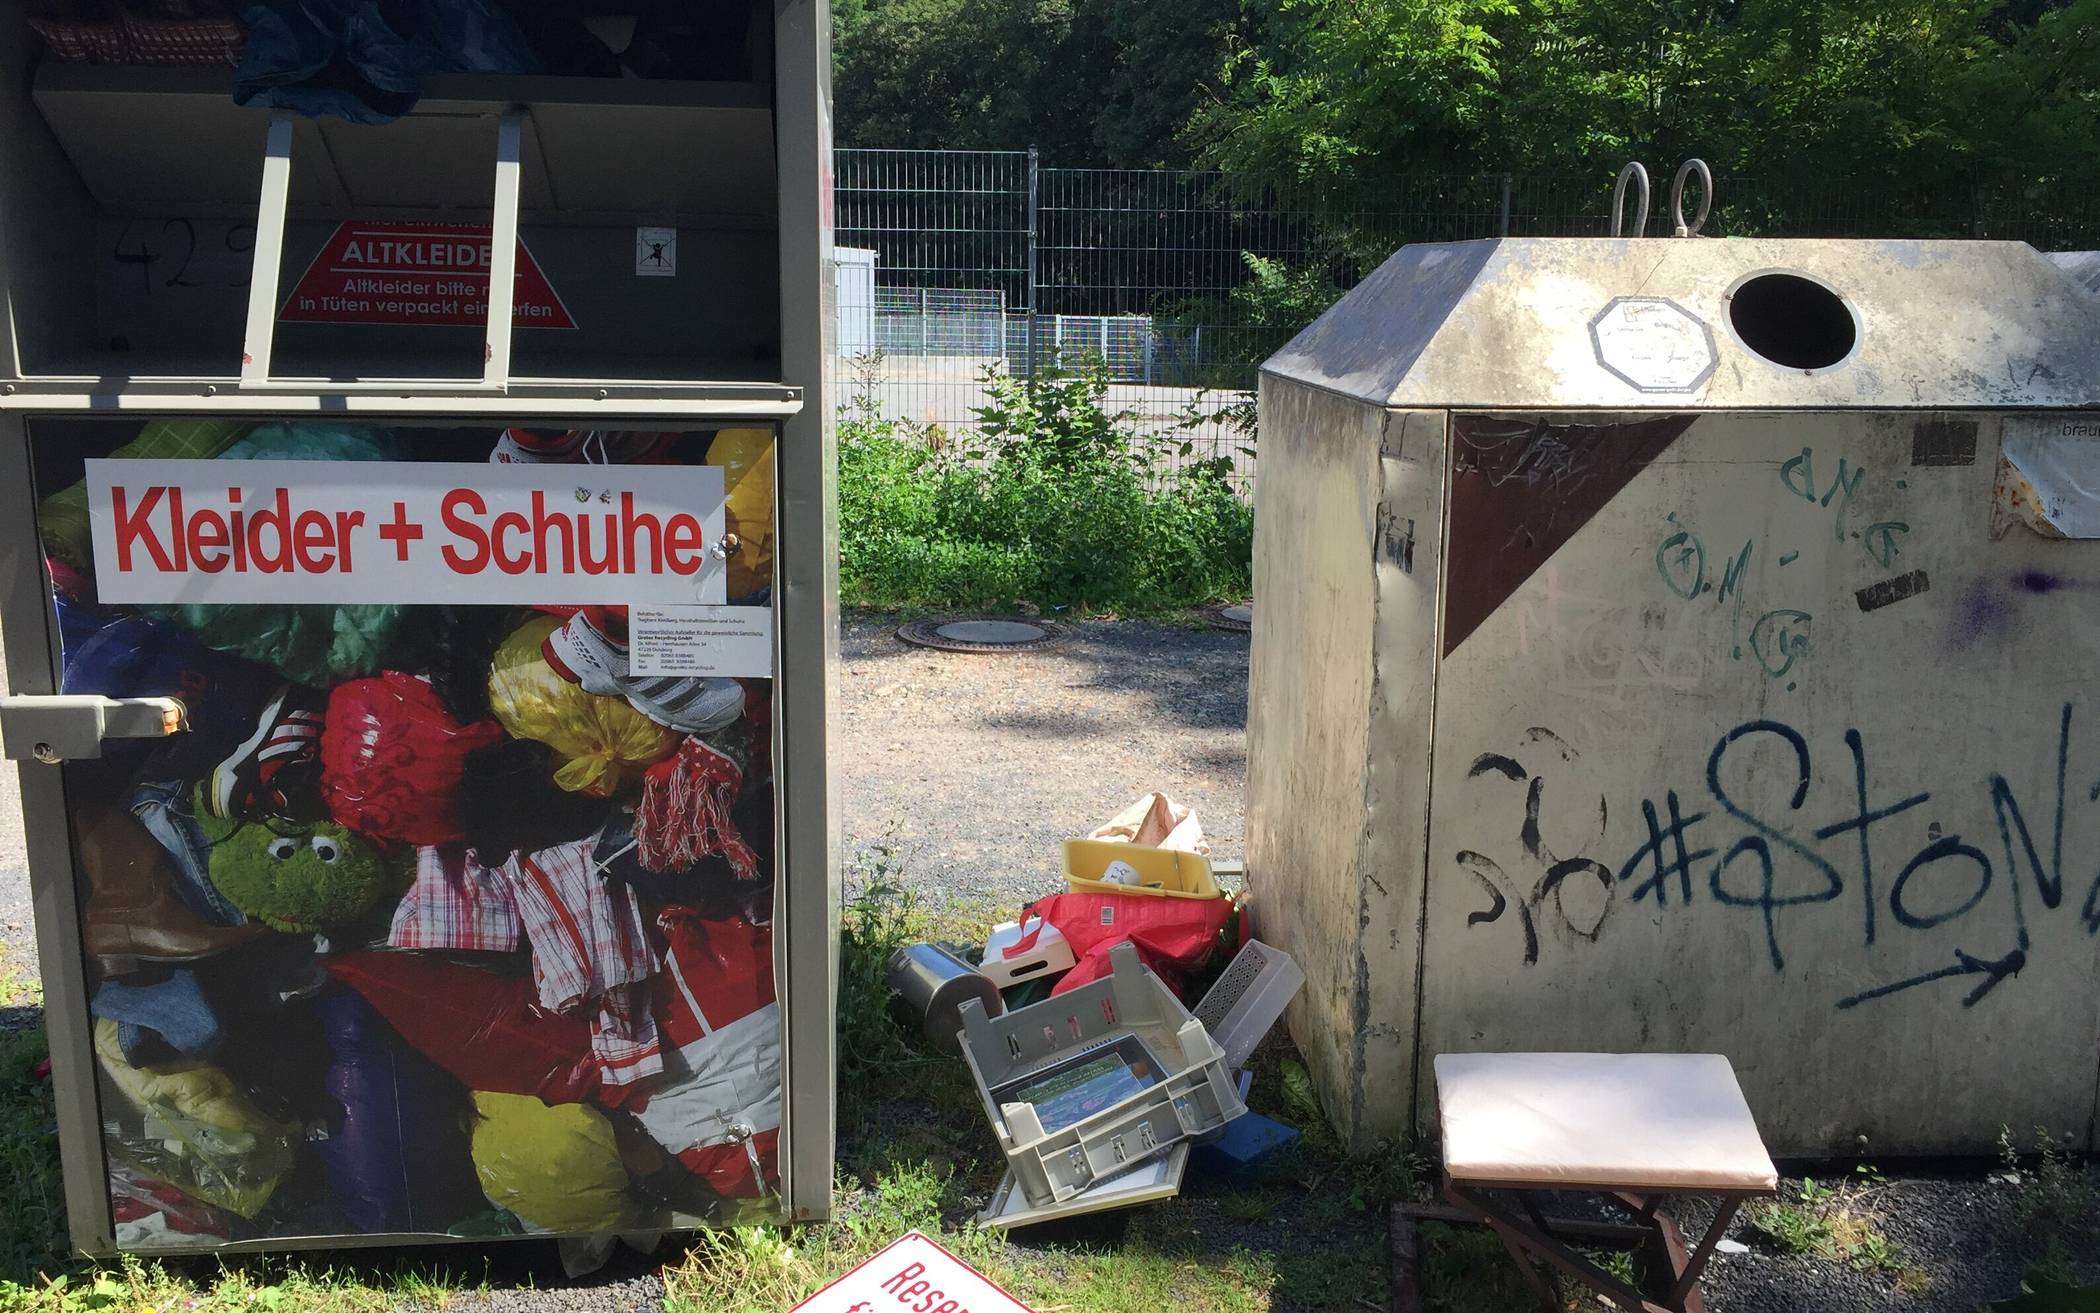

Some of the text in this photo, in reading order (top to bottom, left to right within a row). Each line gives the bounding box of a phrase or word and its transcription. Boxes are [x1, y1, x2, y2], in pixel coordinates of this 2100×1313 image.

[341, 240, 492, 267] ALTKLEIDE
[343, 278, 431, 295] Altkleider
[436, 281, 476, 296] bitte
[300, 296, 553, 317] in Tüten verpackt einerfen
[2062, 422, 2100, 437] brau
[111, 486, 703, 576] Kleider + Schuhe
